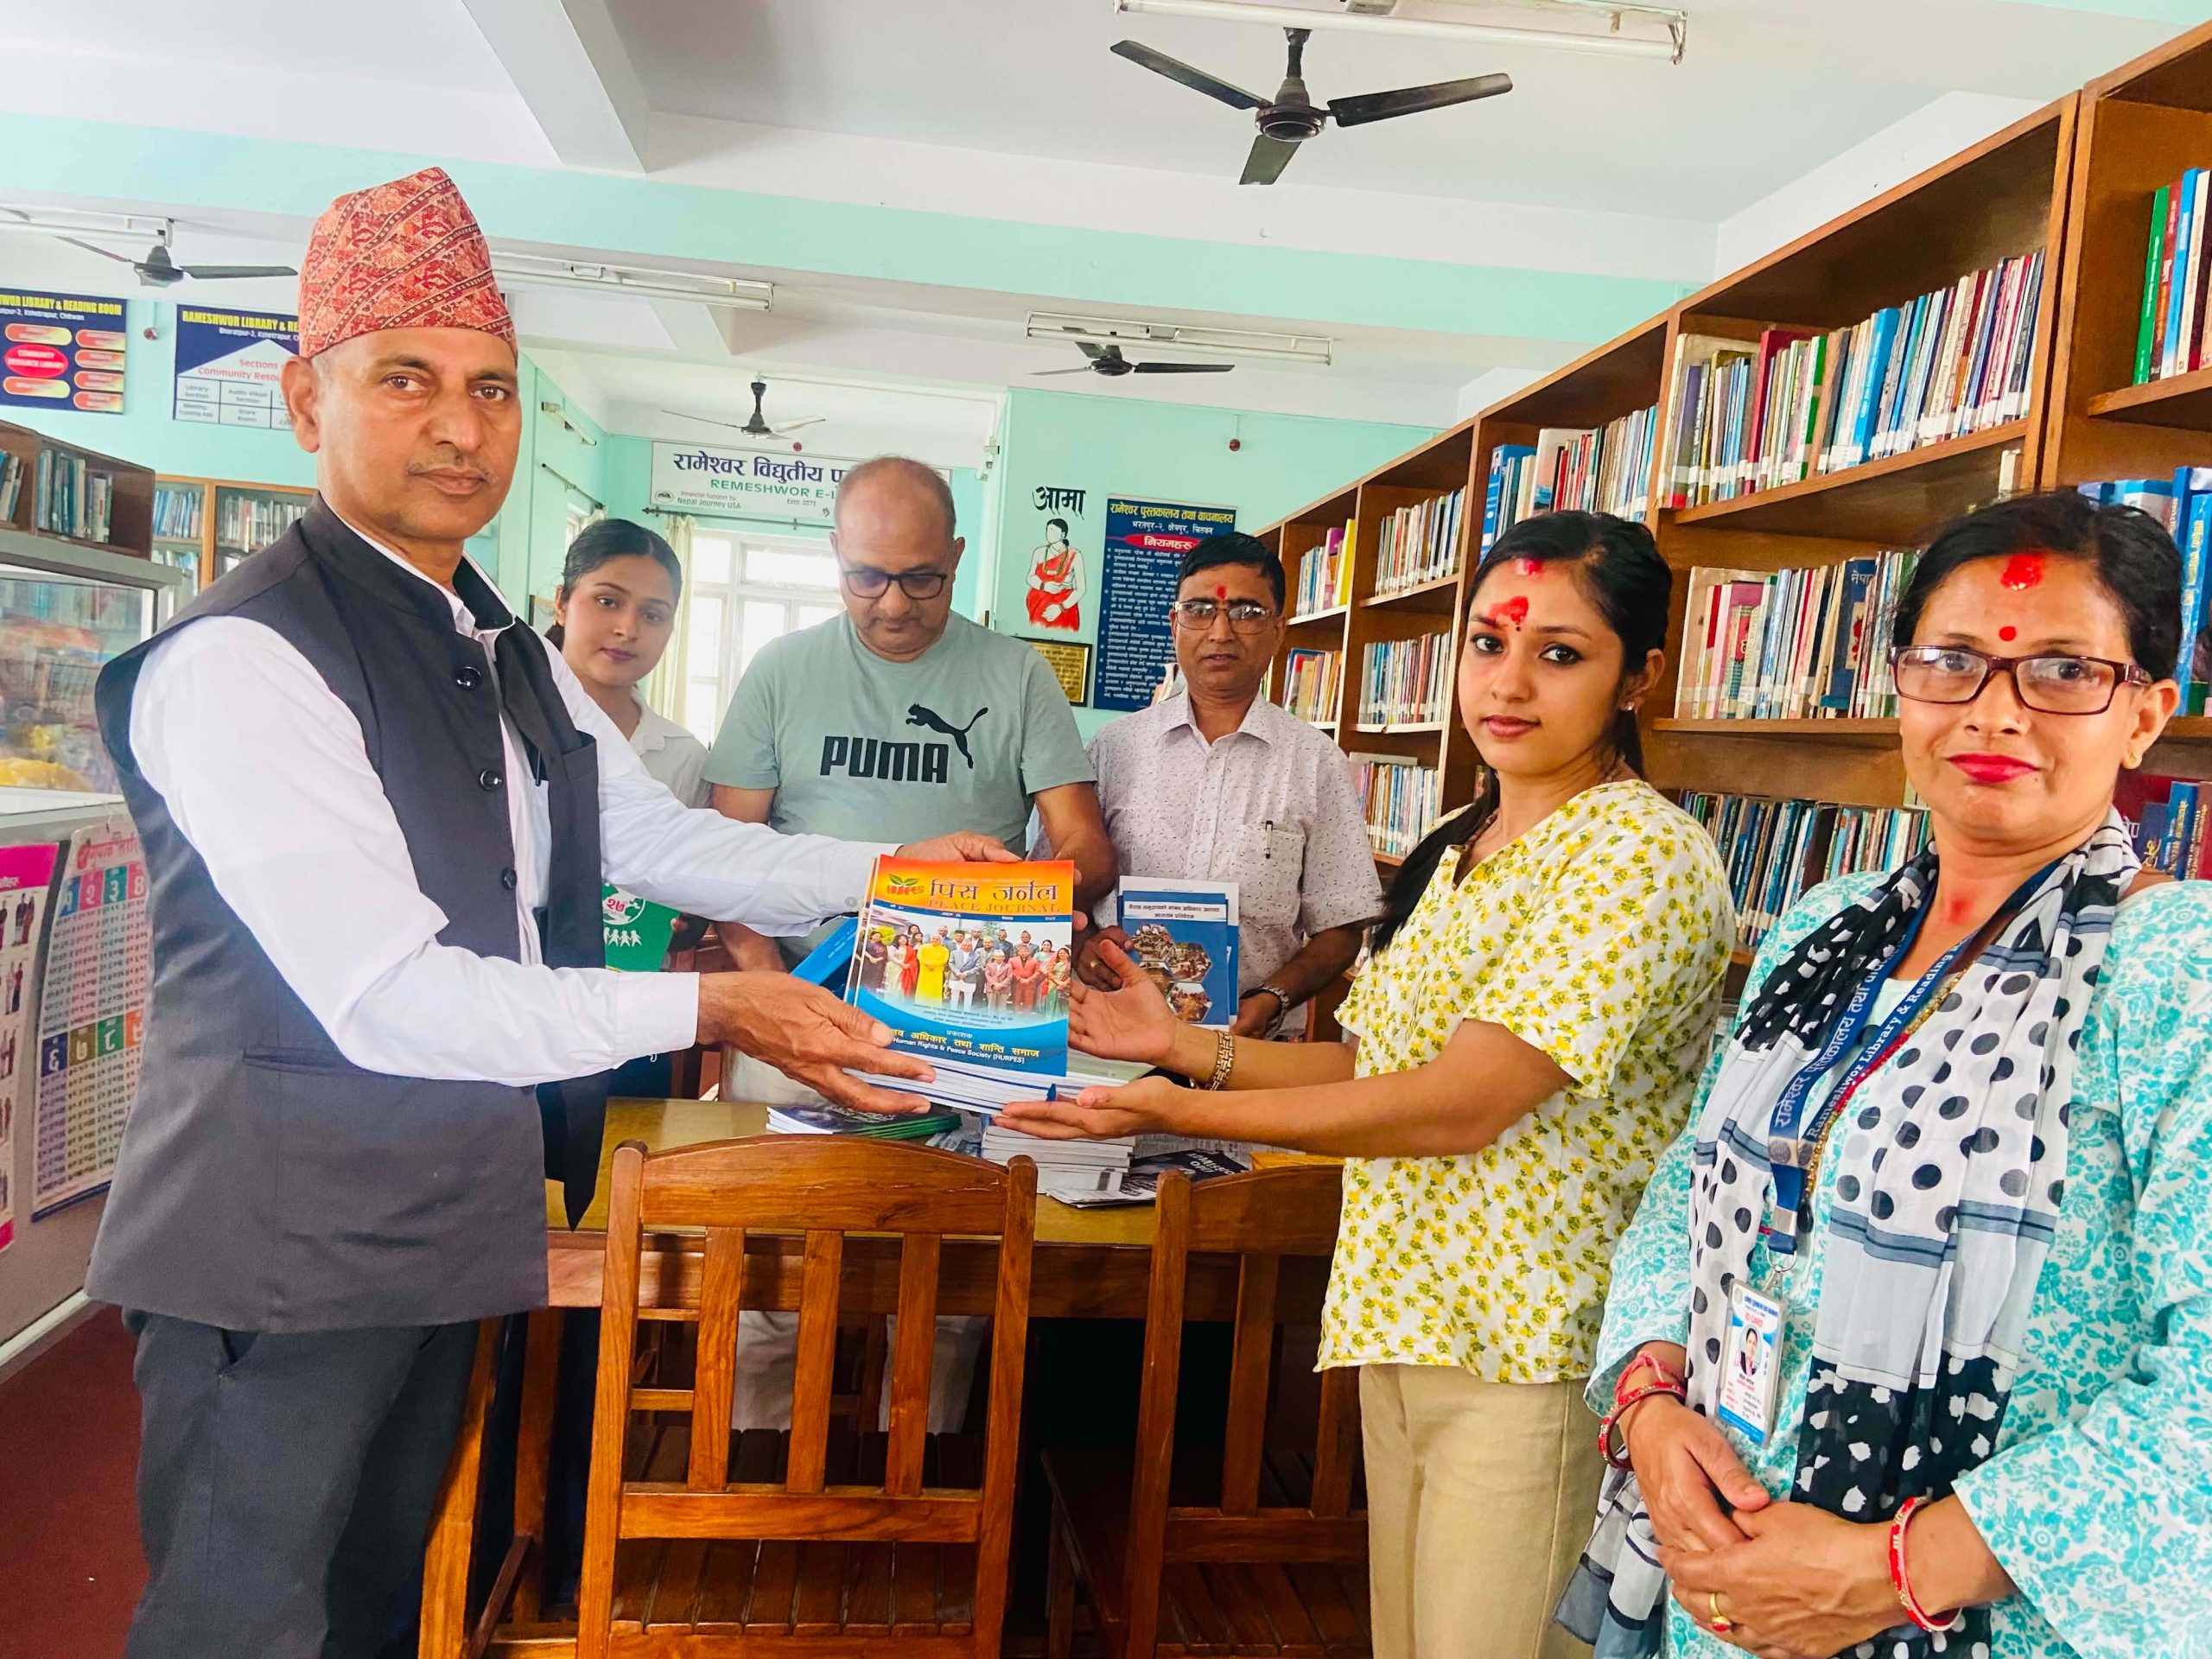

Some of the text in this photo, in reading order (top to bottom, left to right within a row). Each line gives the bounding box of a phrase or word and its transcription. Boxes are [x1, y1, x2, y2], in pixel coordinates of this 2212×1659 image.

[22, 296, 54, 309] LIBRARY
[55, 301, 62, 310] &
[63, 300, 97, 314] READING
[98, 303, 122, 316] ROOM
[182, 310, 239, 327] RAMESHWOR
[241, 316, 277, 330] LIBRARY
[279, 321, 286, 331] &
[198, 367, 251, 380] Community
[673, 450, 747, 476] रामेश्वर
[710, 480, 810, 497] REMESHWOR
[677, 497, 697, 506] Nepal
[698, 499, 726, 508] Journey
[1032, 486, 1087, 520] आमा
[820, 736, 949, 784] PUMA
[993, 880, 1061, 901] जर्नल
[927, 899, 1060, 913] PEACE JOURNAL
[911, 1032, 948, 1045] अधिकार
[1012, 1046, 1039, 1058] समाज
[918, 1039, 938, 1050] Rights
[946, 1046, 966, 1055] Peace
[967, 1049, 992, 1060] Society
[1775, 1075, 1811, 1127] रामेश्वर
[1847, 983, 1870, 1013] तथा
[1807, 1065, 1864, 1136] Rameshwor
[1859, 1017, 1902, 1064] Library
[1897, 1005, 1911, 1014] &
[1906, 954, 1955, 1003] Reading
